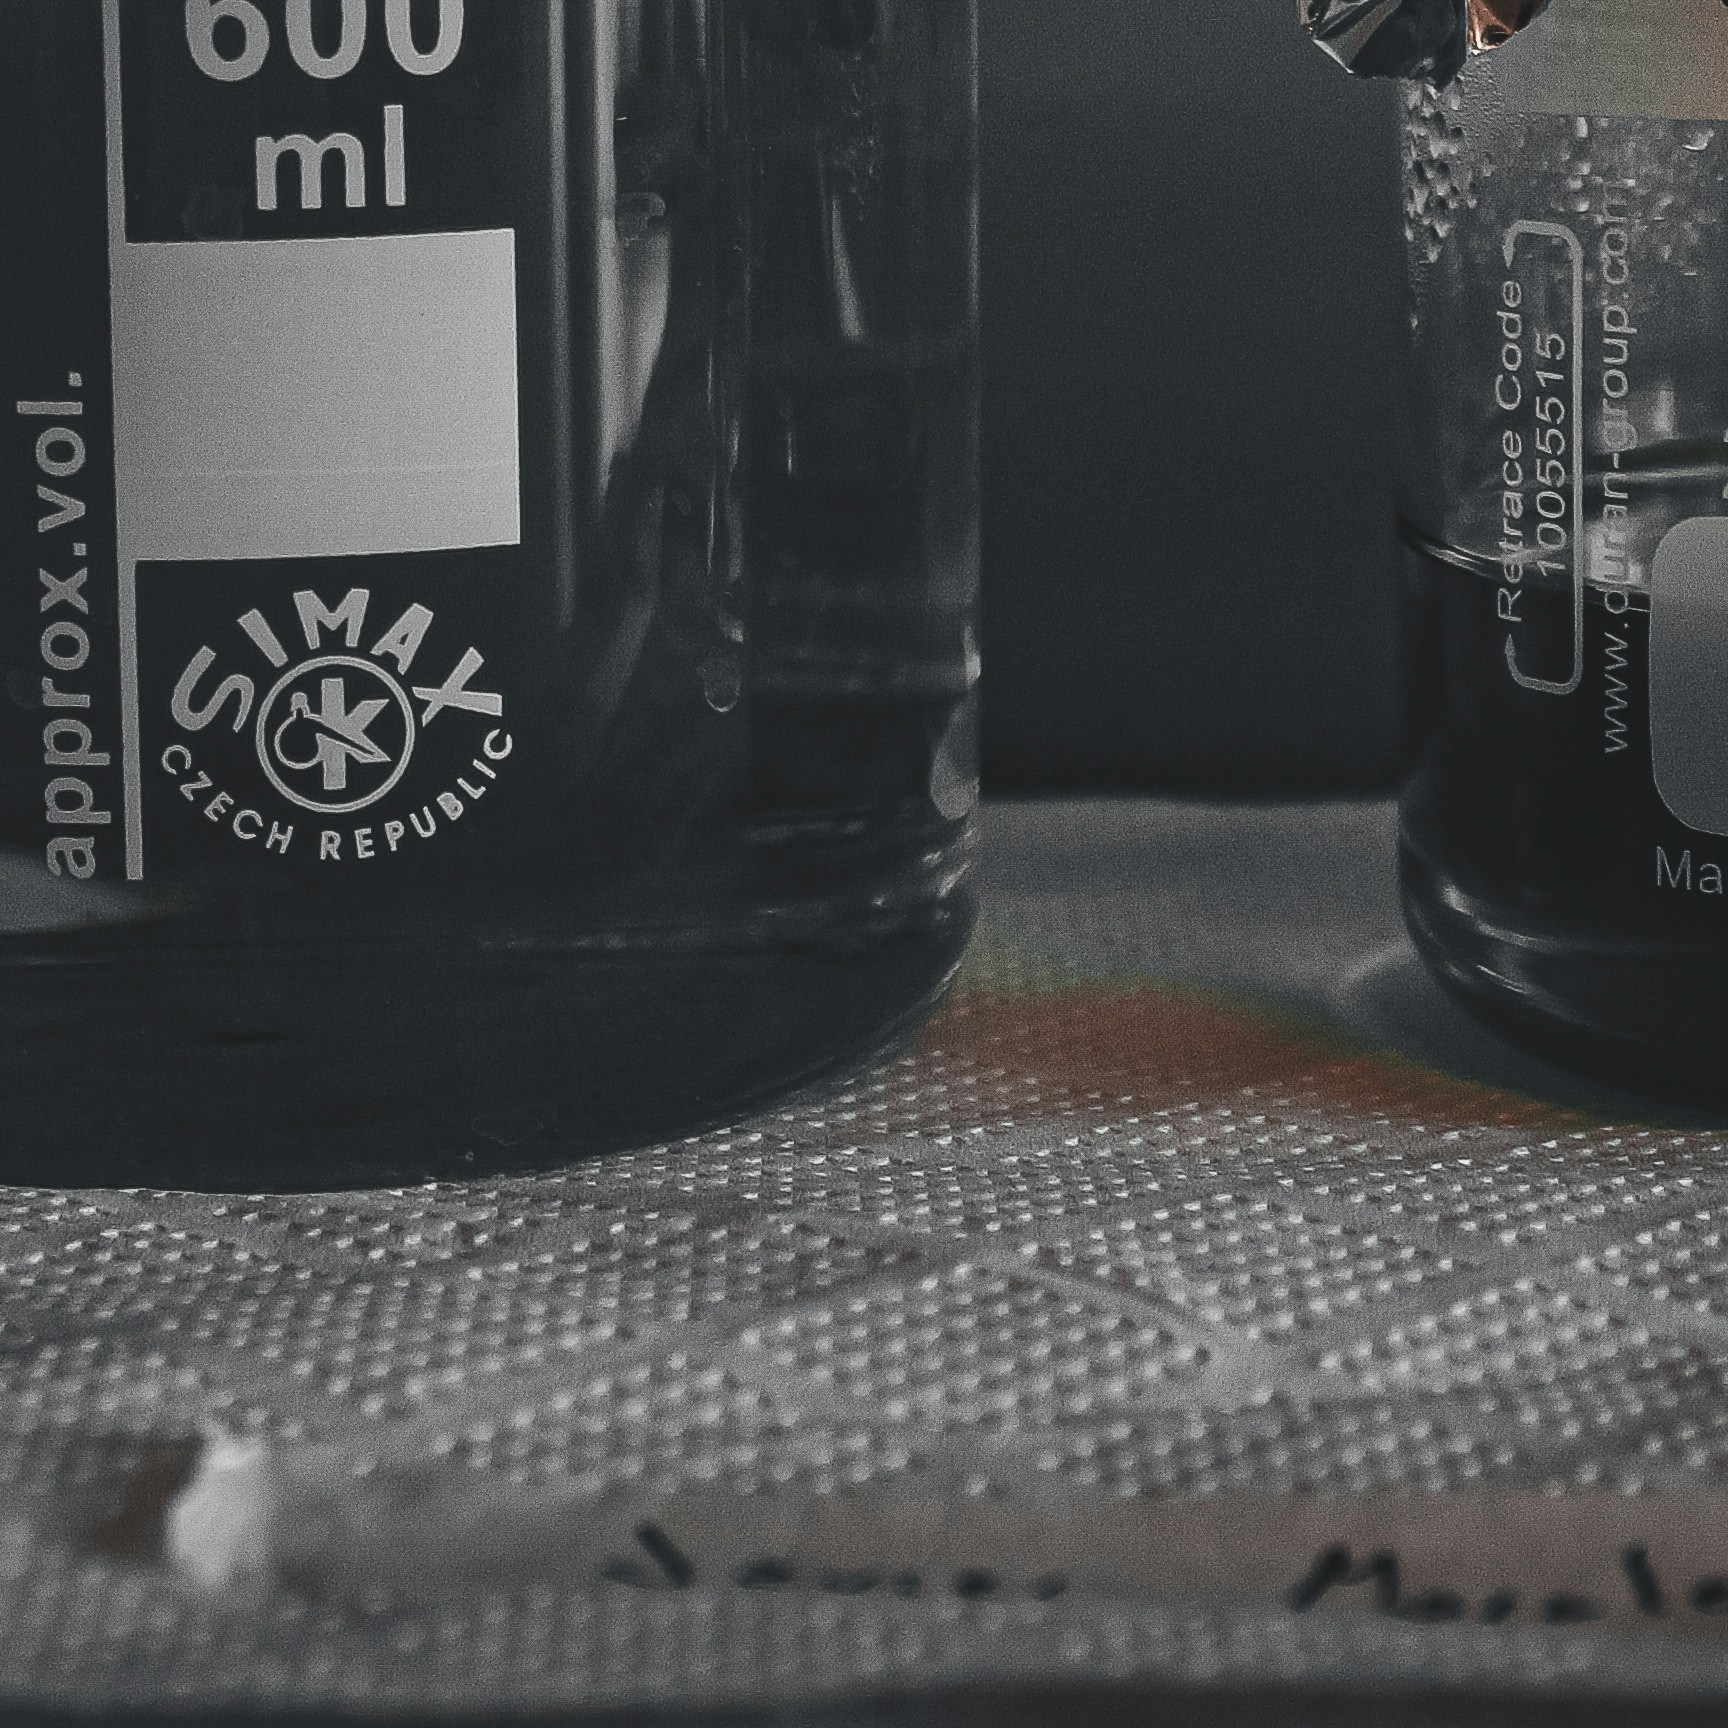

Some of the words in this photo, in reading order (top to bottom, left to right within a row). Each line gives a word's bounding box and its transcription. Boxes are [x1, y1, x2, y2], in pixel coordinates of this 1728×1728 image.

[254, 104, 407, 211] ml
[1493, 279, 1524, 414] Code
[1535, 332, 1567, 579] 10055515
[1495, 428, 1524, 624] Retrace
[171, 587, 504, 733] SIMAX
[160, 743, 294, 854] CZECH
[319, 727, 514, 861] REPUBLIC
